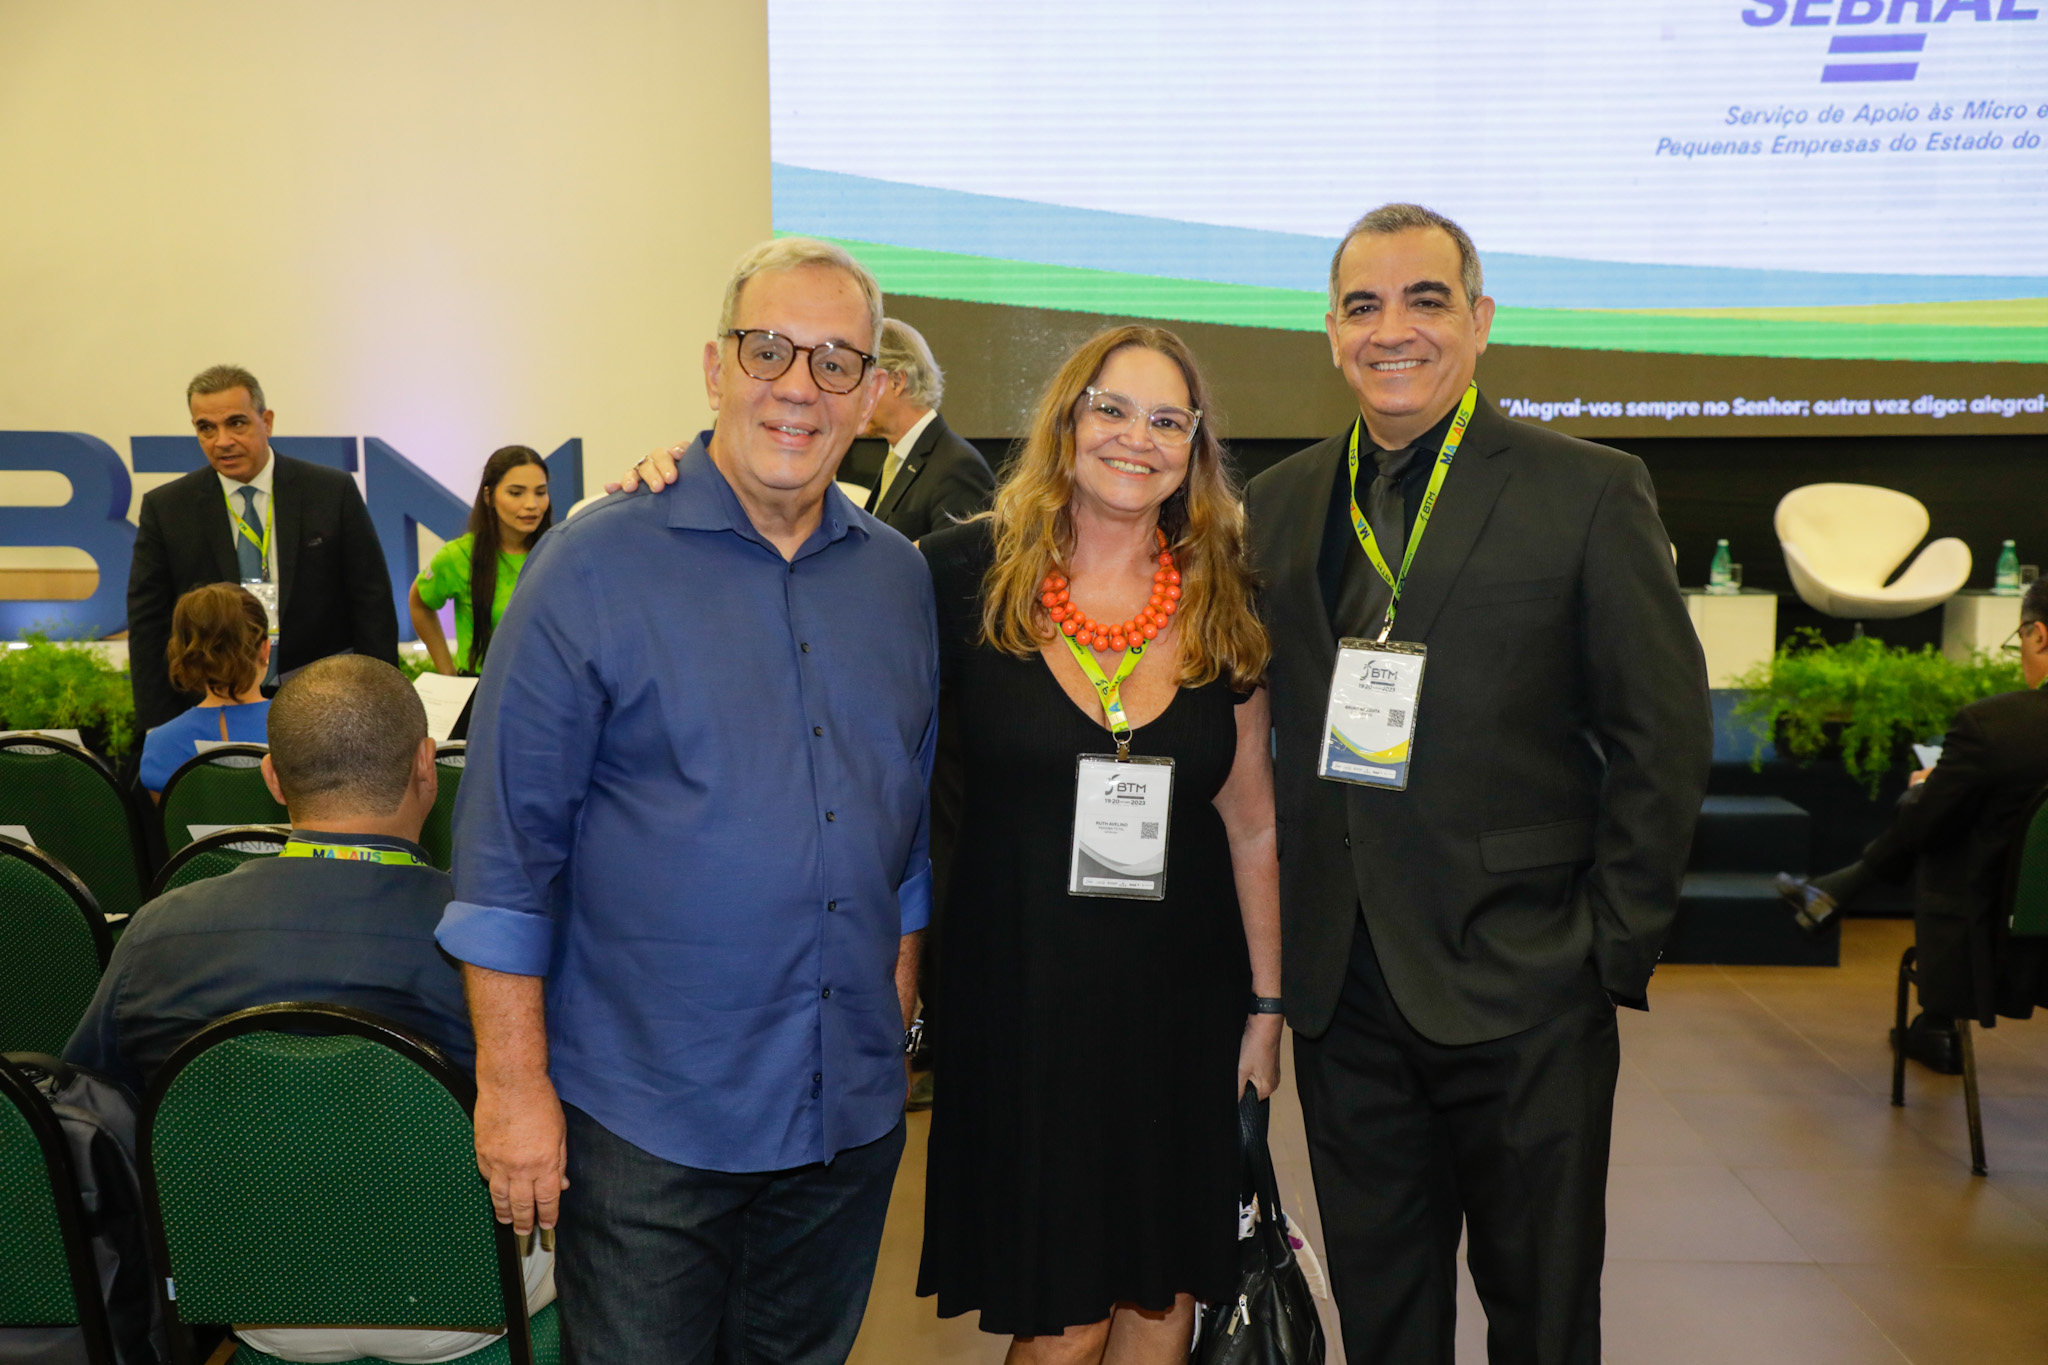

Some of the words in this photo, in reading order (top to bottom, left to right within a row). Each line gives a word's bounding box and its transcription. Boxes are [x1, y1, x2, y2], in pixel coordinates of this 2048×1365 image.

[1725, 105, 1808, 128] Serviço
[1818, 105, 1844, 124] de
[1853, 102, 1919, 126] Apoio
[1928, 102, 1953, 121] às
[1963, 100, 2028, 120] Micro
[2038, 104, 2048, 119] e
[1656, 137, 1763, 159] Pequenas
[1771, 134, 1881, 157] Empresas
[1889, 133, 1917, 151] do
[1926, 131, 2003, 151] Estado
[2013, 130, 2041, 149] do
[1625, 400, 1700, 420] sempre
[1703, 401, 1730, 417] no
[1812, 398, 1871, 416] outra
[1873, 399, 1910, 415] vez
[1911, 395, 1967, 418] digo:
[1440, 408, 1470, 465] MANAUS
[1422, 491, 1436, 514] BTM
[1371, 668, 1398, 680] BTM
[1117, 782, 1146, 793] BTM
[312, 848, 382, 863] MANAUS
